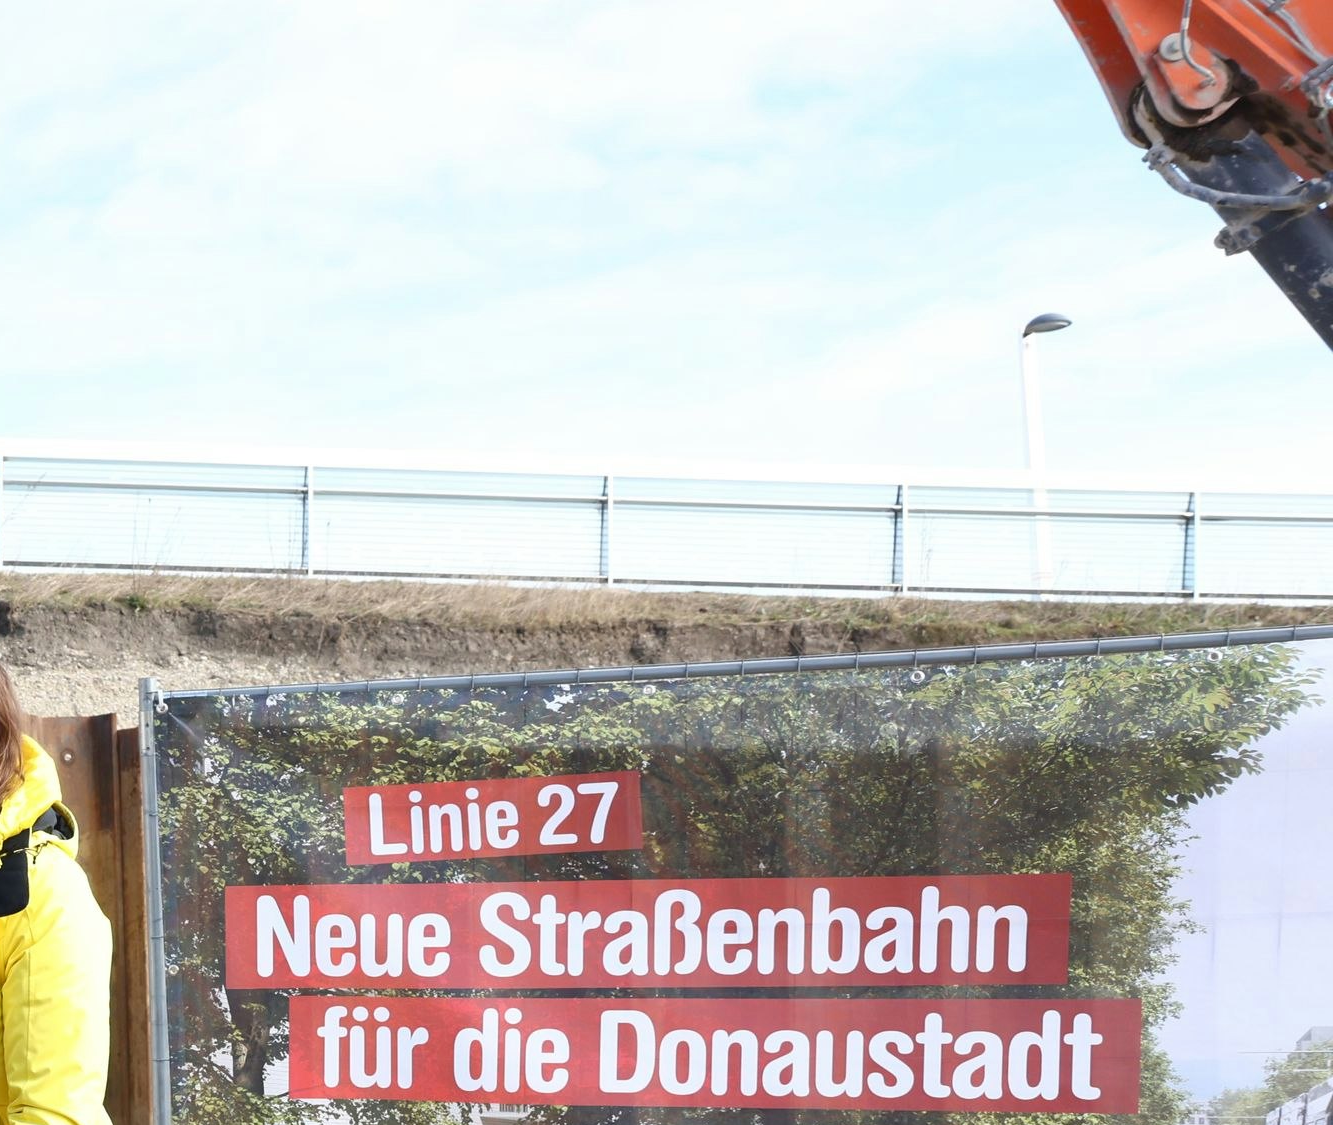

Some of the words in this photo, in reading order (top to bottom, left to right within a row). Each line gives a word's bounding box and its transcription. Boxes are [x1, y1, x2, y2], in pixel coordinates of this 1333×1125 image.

[368, 785, 520, 857] Linie
[537, 781, 619, 846] 27
[256, 893, 451, 979] Neue
[478, 885, 1029, 978] Straßenbahn
[316, 1005, 430, 1090] für
[453, 1007, 570, 1094] die
[599, 1009, 1104, 1102] Donaustadt
